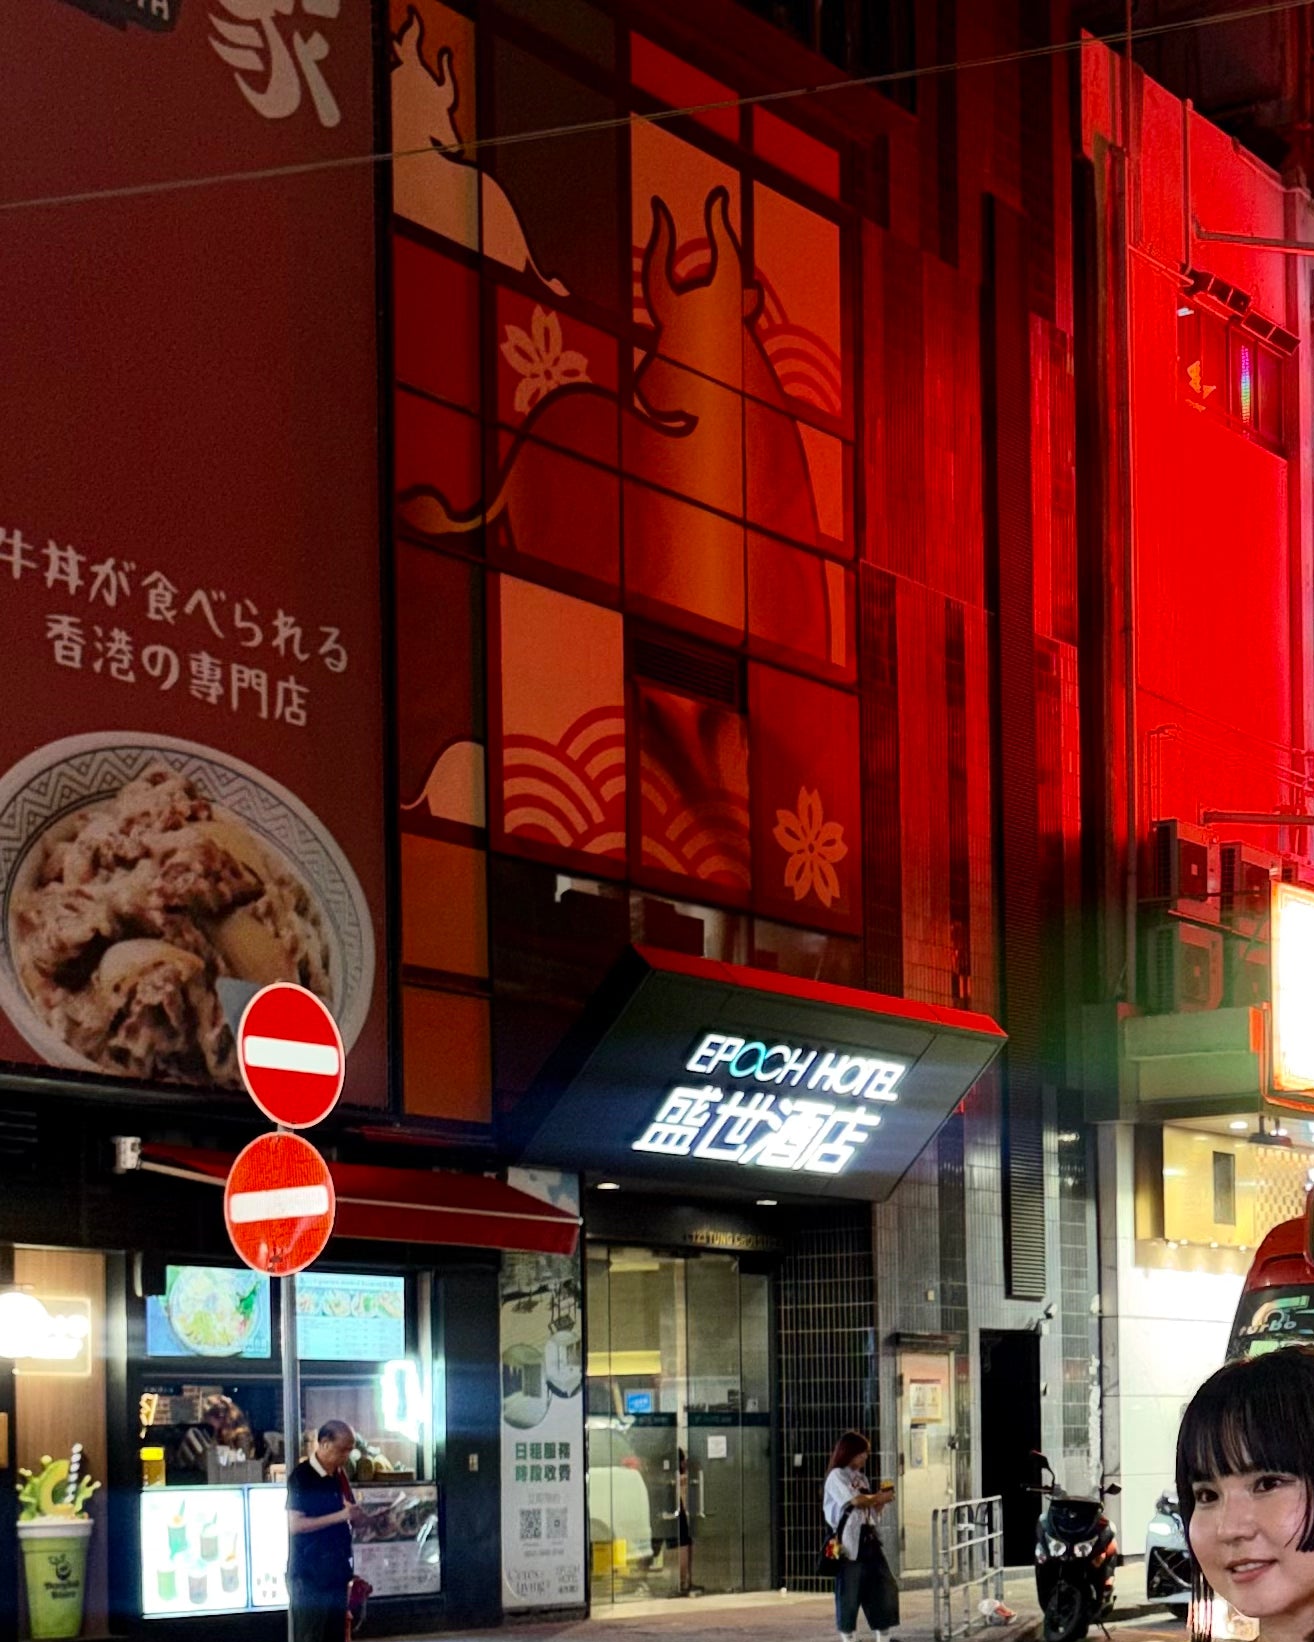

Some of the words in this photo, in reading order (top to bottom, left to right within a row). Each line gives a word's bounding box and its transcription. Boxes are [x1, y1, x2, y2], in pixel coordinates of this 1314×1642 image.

[685, 1032, 817, 1088] EPOCH
[806, 1051, 906, 1102] HOTEL
[631, 1085, 882, 1174] 盛世酒店
